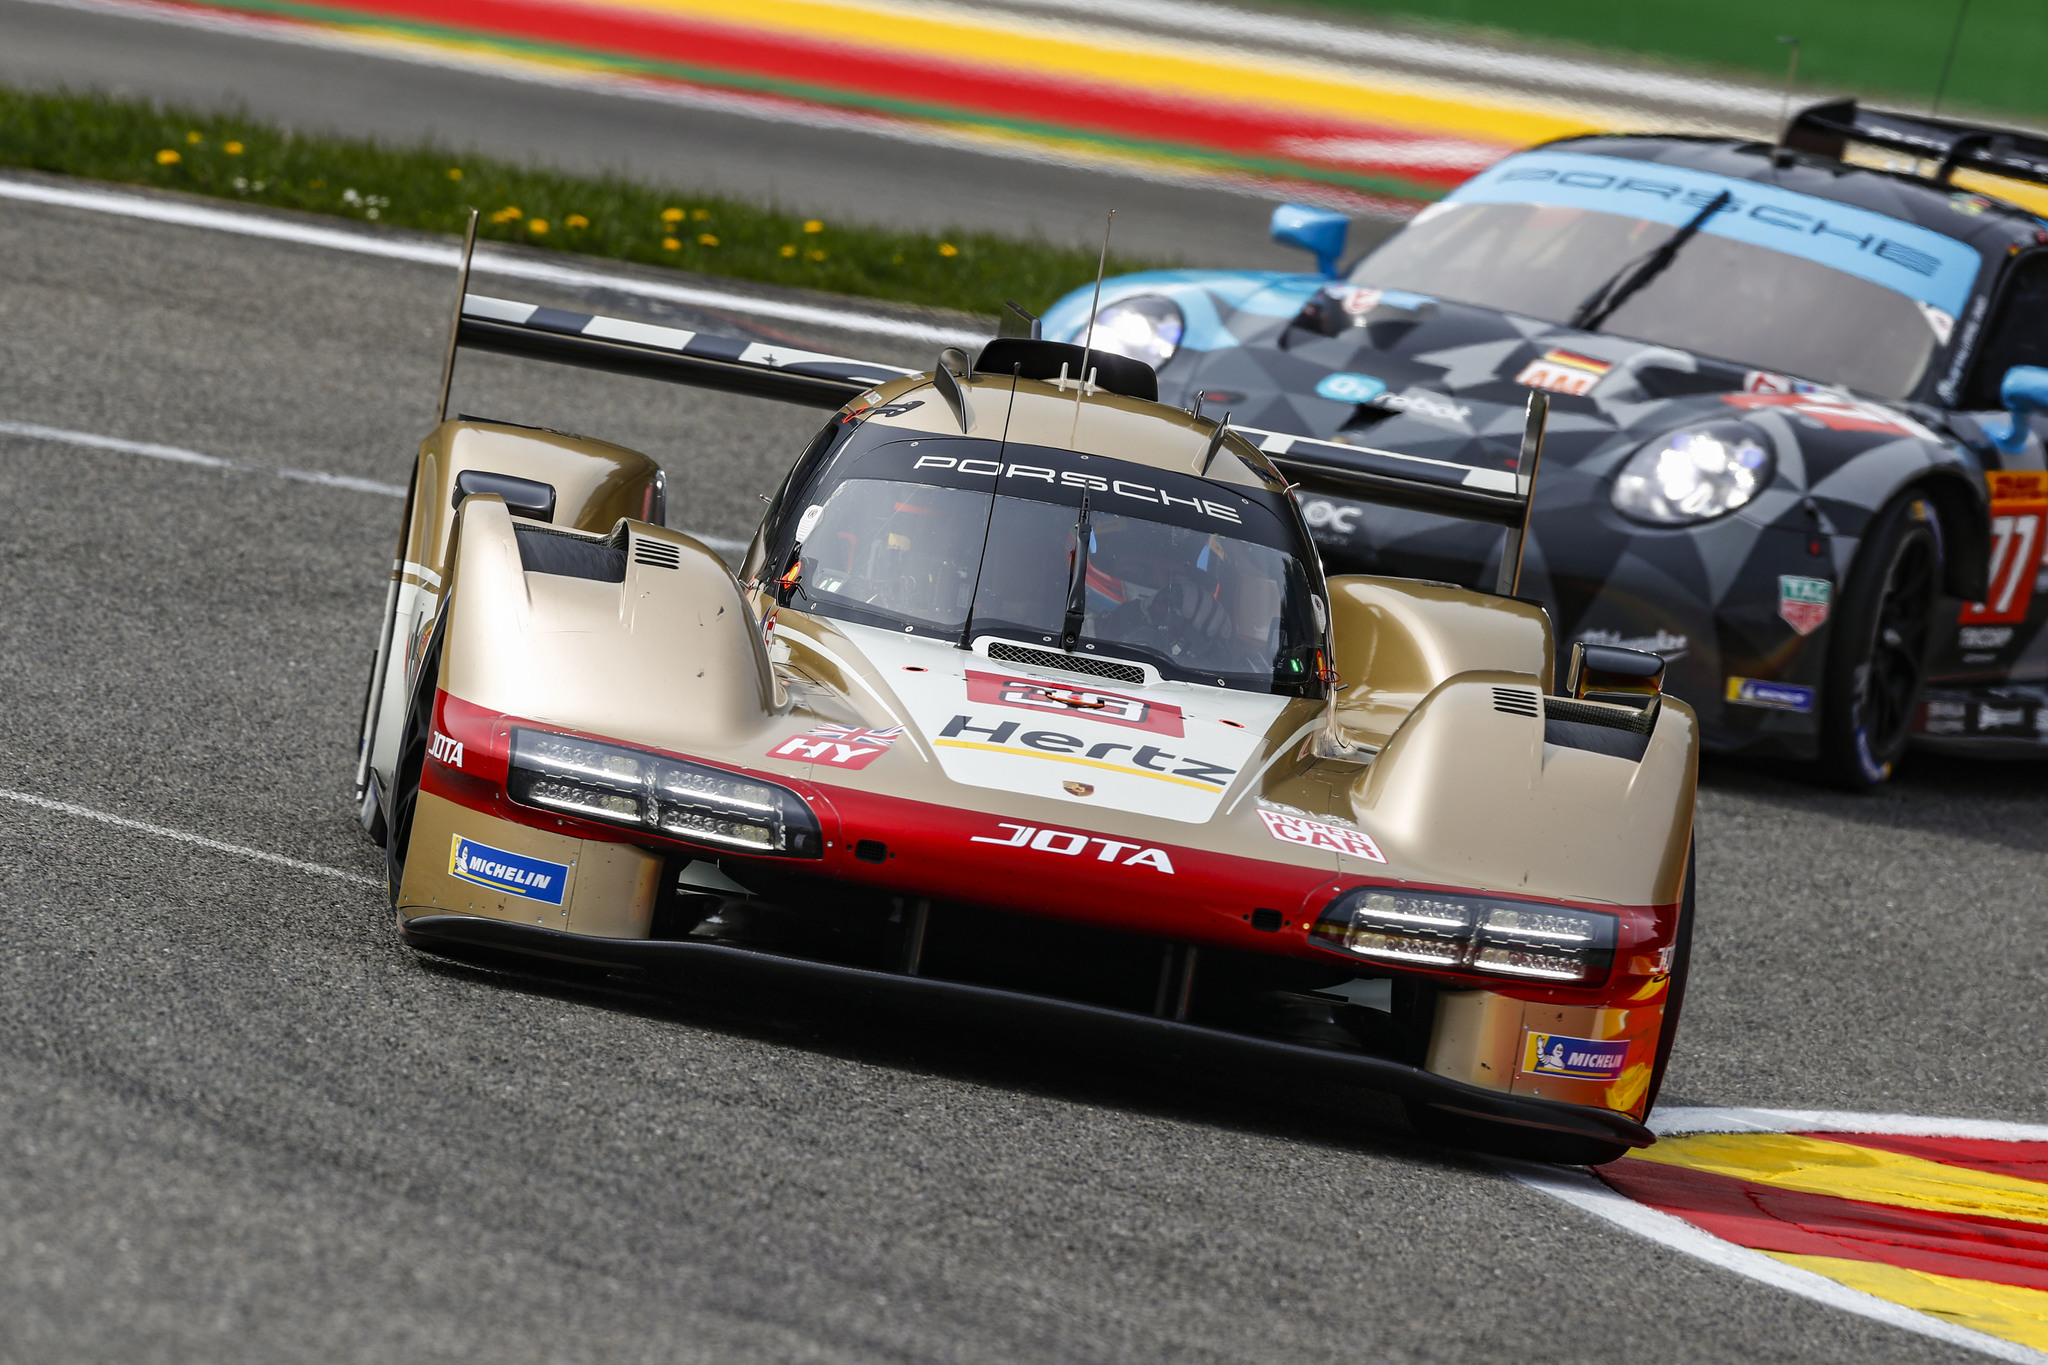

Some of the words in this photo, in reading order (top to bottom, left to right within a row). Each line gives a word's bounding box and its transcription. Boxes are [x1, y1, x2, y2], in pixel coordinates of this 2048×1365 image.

[1500, 167, 1942, 277] PORSCHE
[913, 455, 1243, 525] PORSCHE
[428, 731, 464, 768] JOTA
[775, 738, 880, 763] HY
[938, 714, 1237, 786] Hertz
[1263, 812, 1365, 843] HYPER
[1273, 823, 1379, 860] CAR
[970, 822, 1176, 875] JOTA
[469, 856, 552, 889] MICHELIN
[1567, 1052, 1624, 1069] MICHELIN
